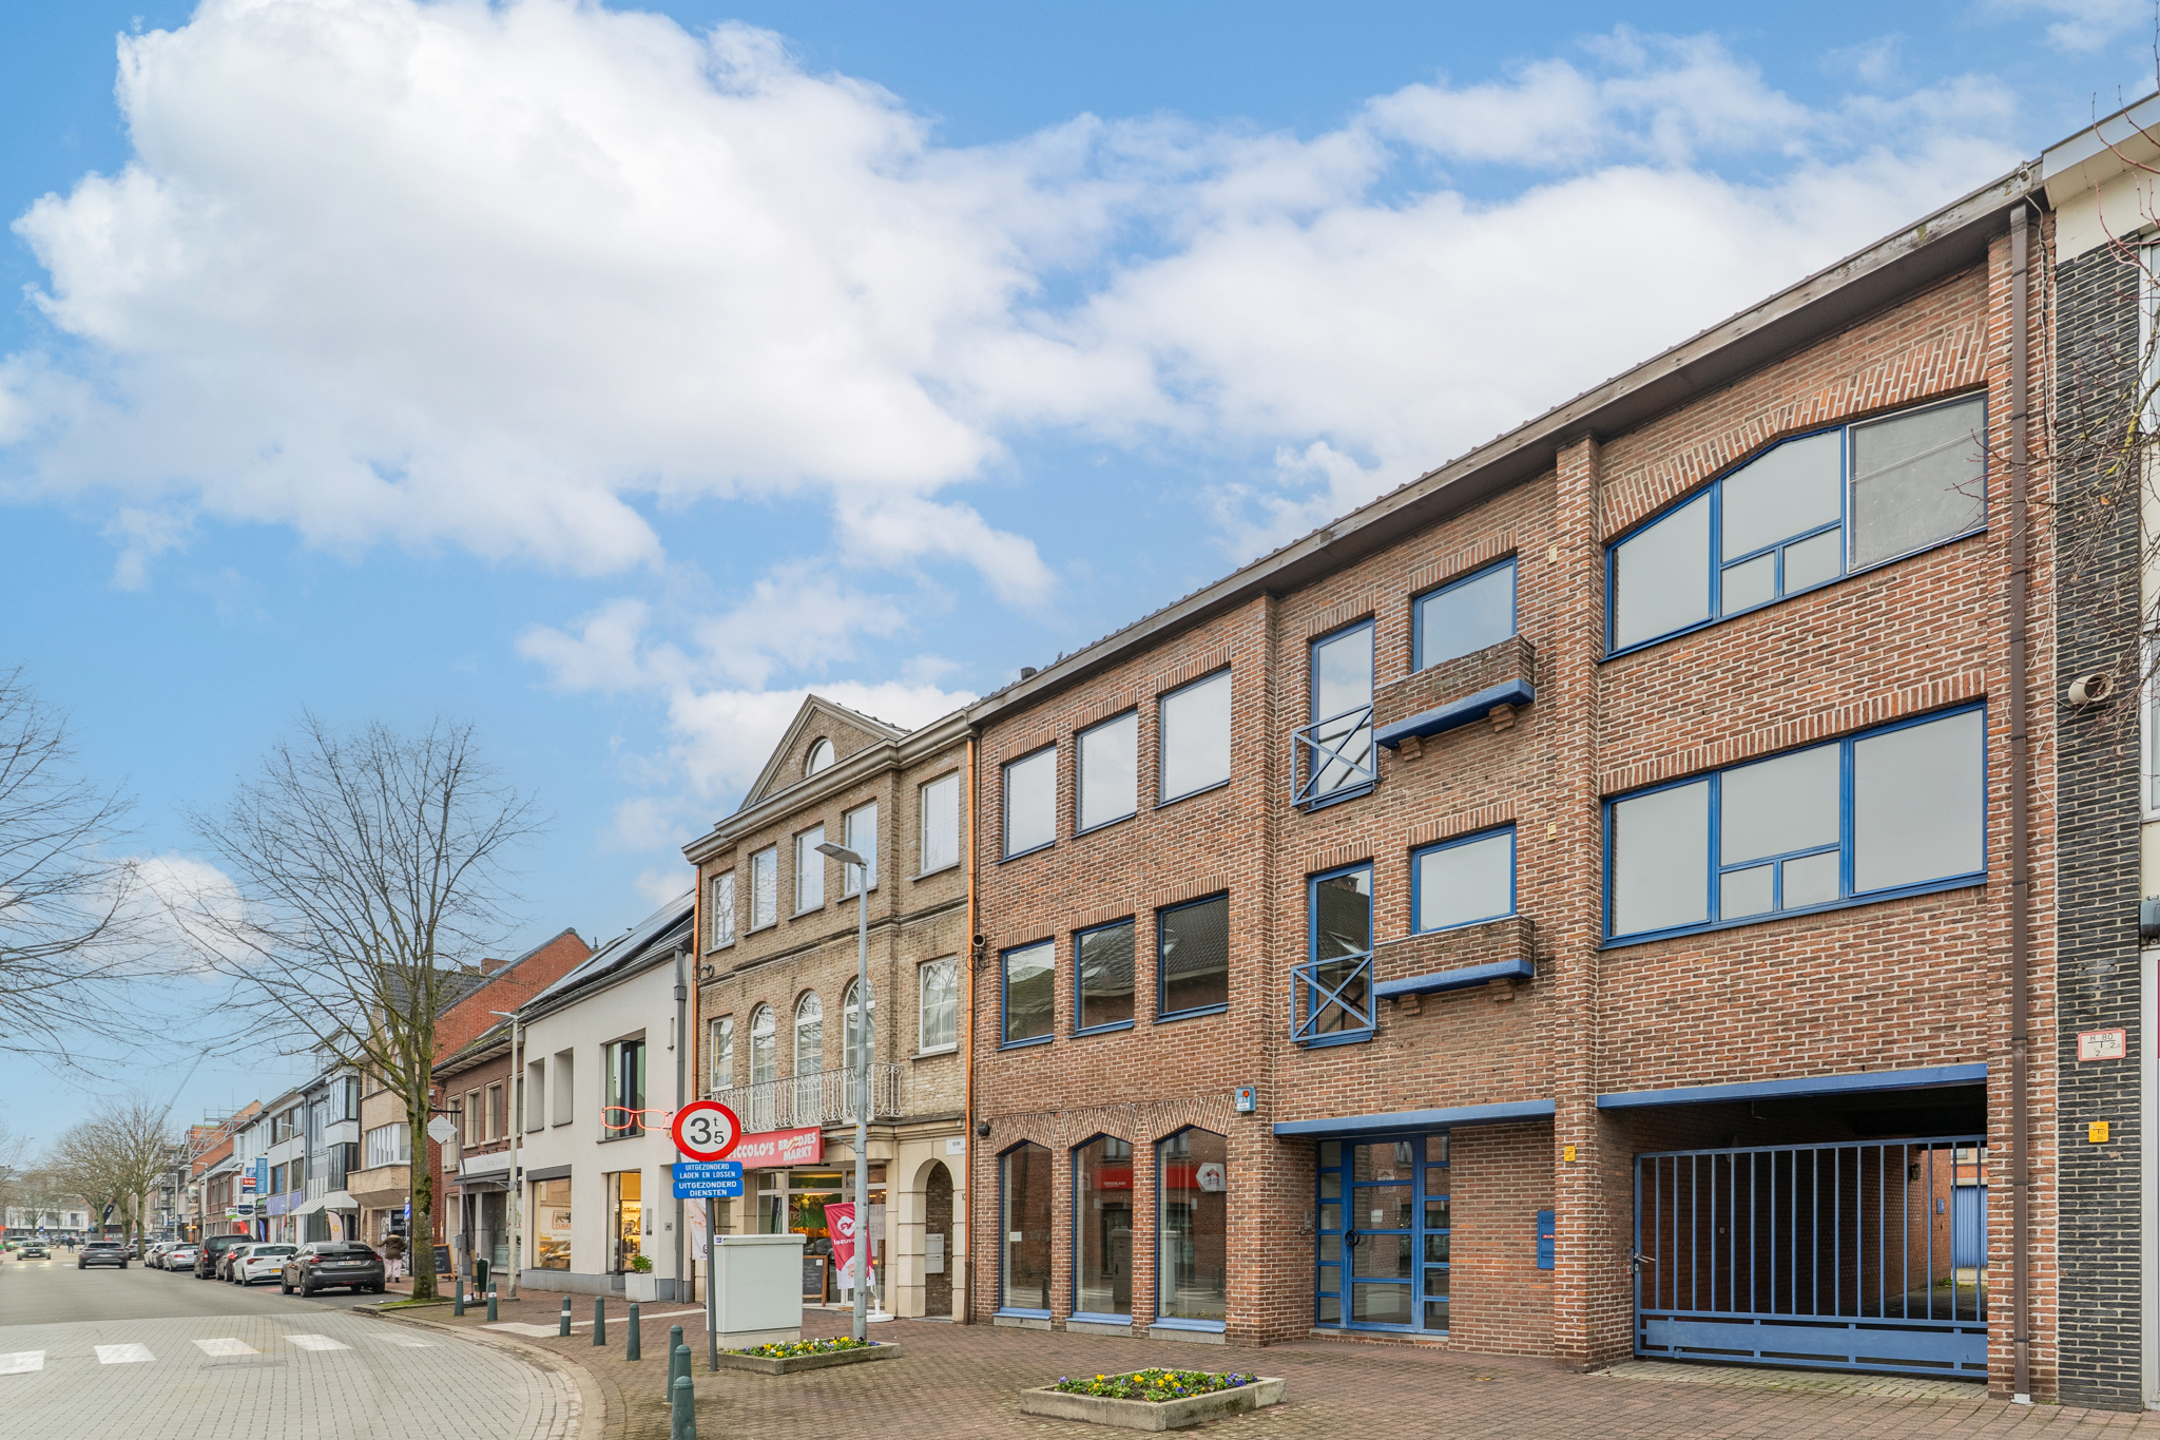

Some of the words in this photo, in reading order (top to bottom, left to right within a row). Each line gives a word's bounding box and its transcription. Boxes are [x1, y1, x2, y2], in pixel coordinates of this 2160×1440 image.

[690, 1117, 712, 1145] 3
[713, 1117, 719, 1127] t
[714, 1131, 725, 1144] 5
[727, 1142, 775, 1159] ICCOLO'S
[783, 1146, 812, 1162] MARKT
[685, 1163, 730, 1171] UITGEZONDERD
[713, 1170, 736, 1178] LOSSEN
[678, 1180, 737, 1189] UITGEZONDERD
[689, 1188, 728, 1197] DIENSTEN
